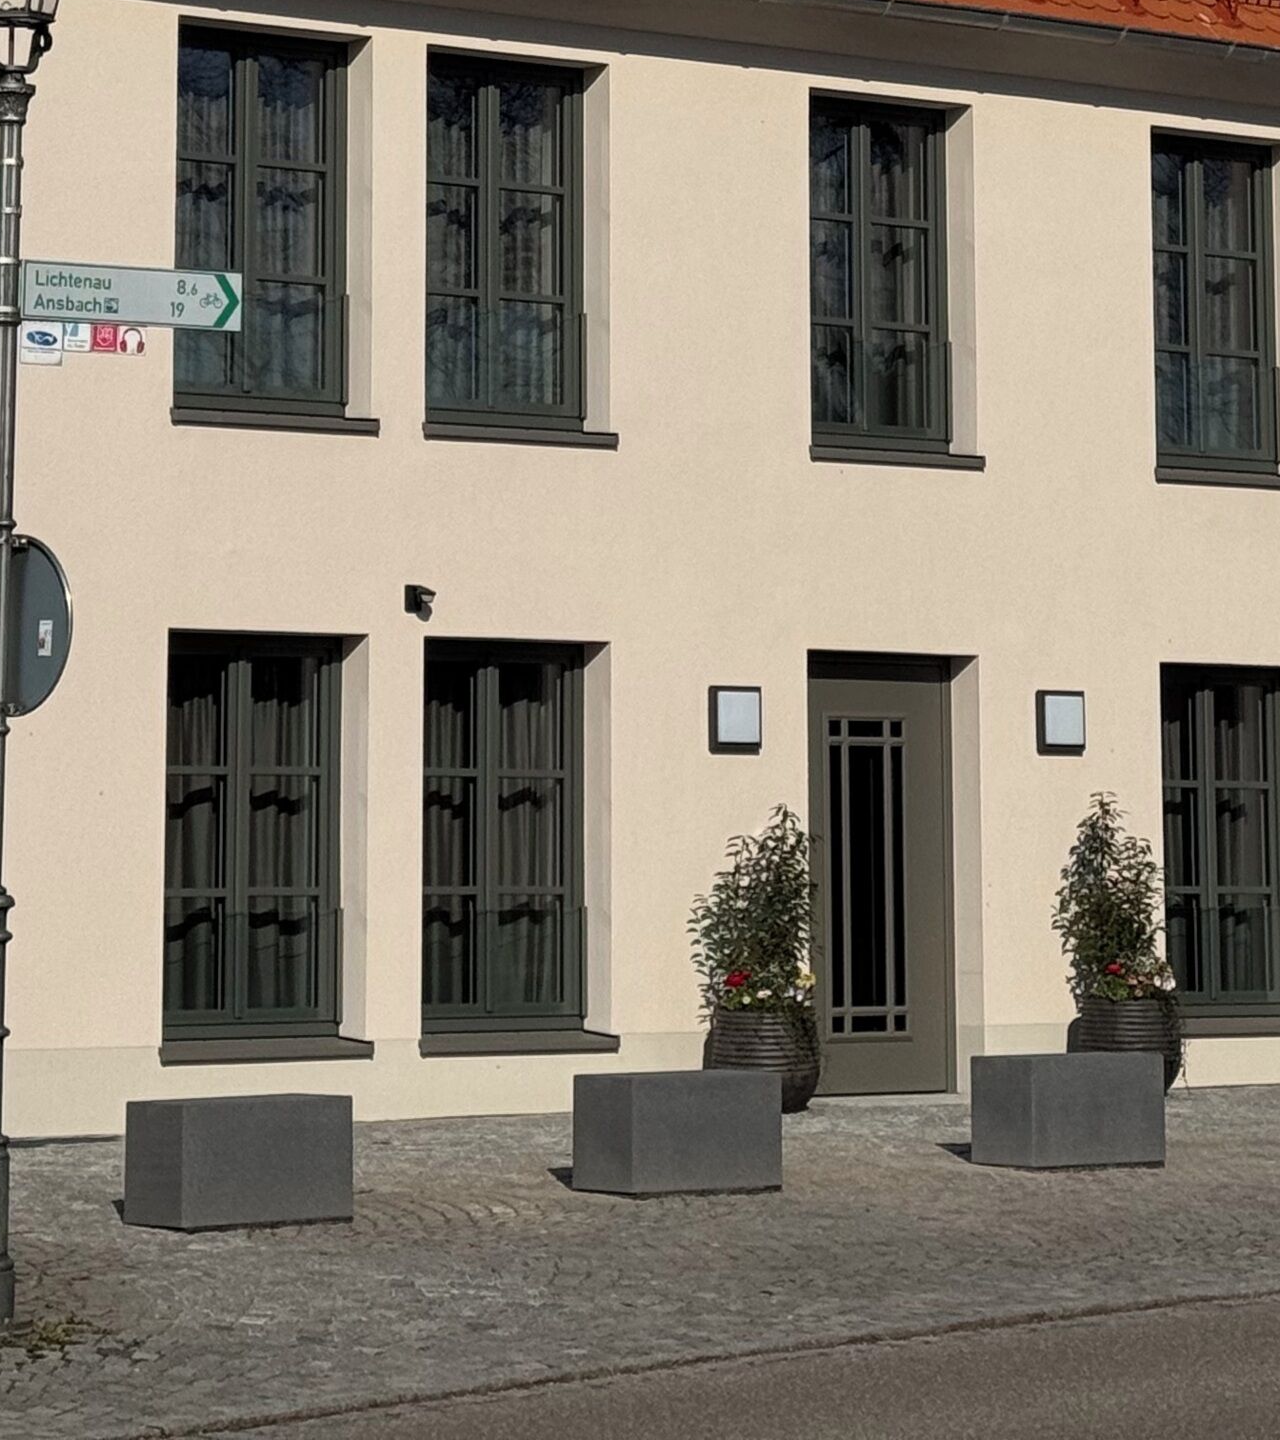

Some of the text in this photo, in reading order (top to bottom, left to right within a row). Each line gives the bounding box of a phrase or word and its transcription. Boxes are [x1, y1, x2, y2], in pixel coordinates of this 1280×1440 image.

[35, 270, 112, 290] Lichtenau
[33, 294, 185, 319] Ansbach 19
